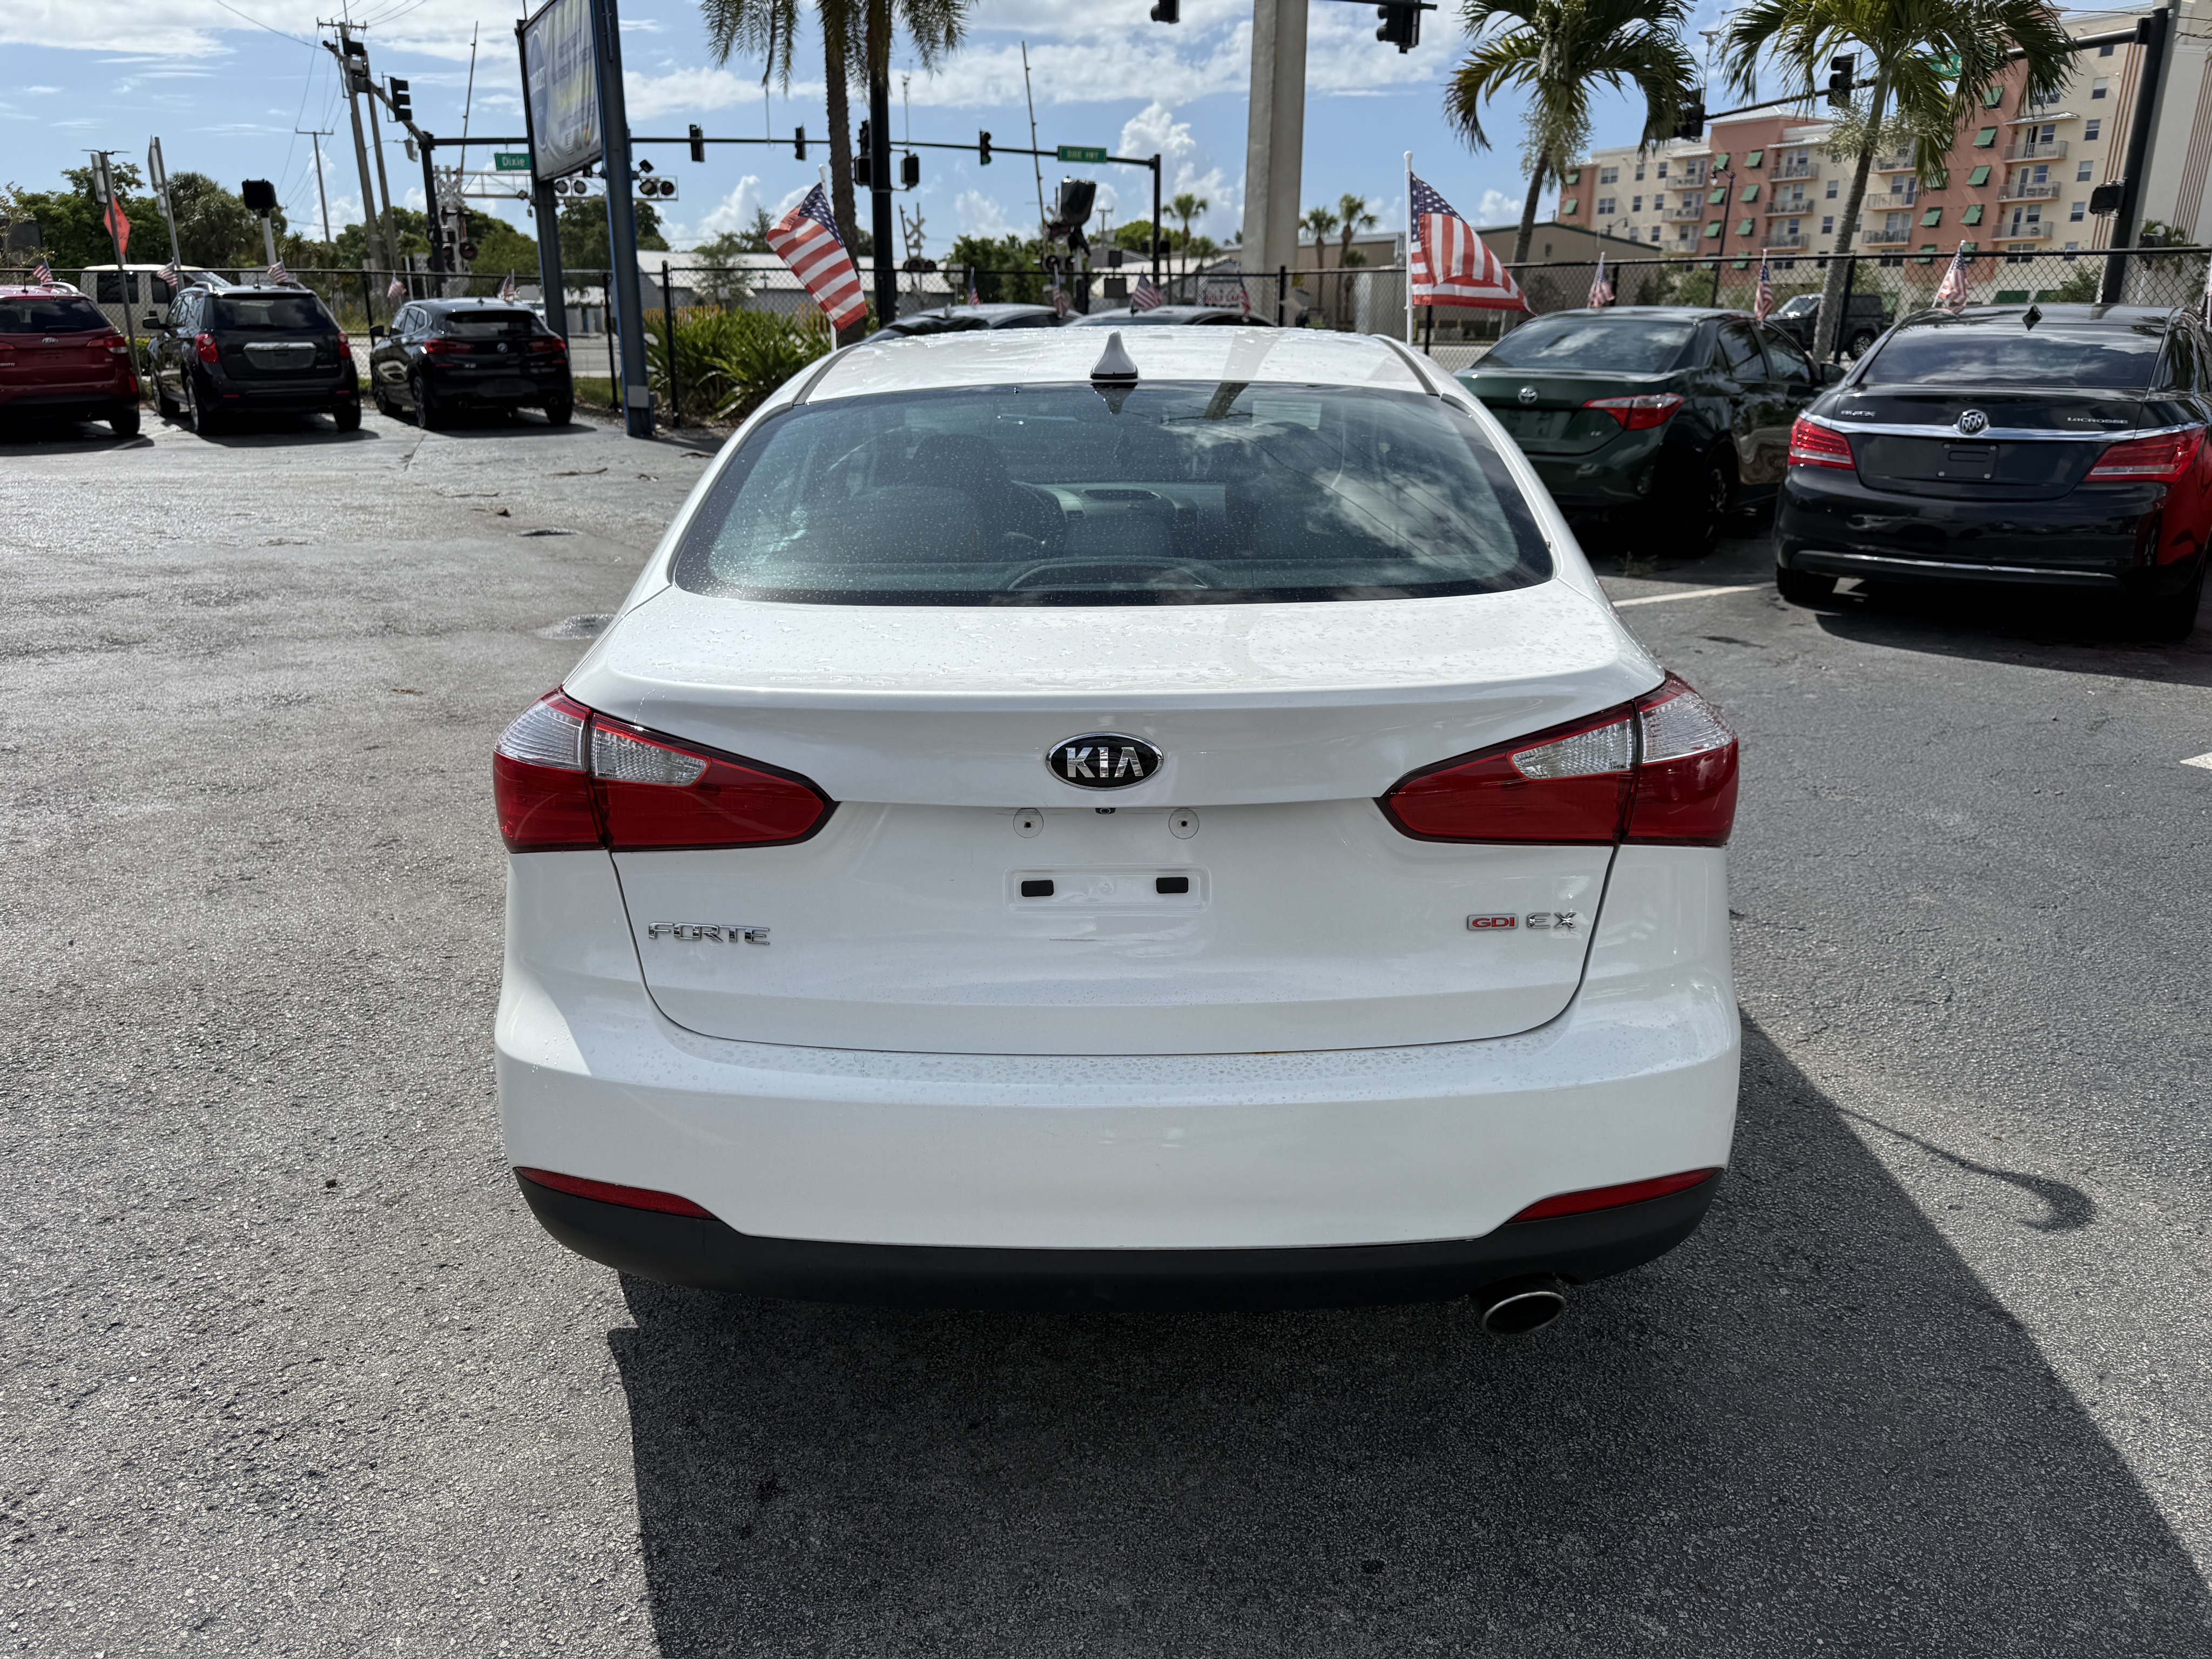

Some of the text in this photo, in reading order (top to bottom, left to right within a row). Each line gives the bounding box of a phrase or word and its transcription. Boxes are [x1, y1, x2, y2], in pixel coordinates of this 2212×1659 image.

[502, 156, 525, 167] Dixie
[1065, 747, 1144, 778] KIA
[1472, 912, 1577, 929] GDI EX
[649, 922, 770, 945] FORTE
